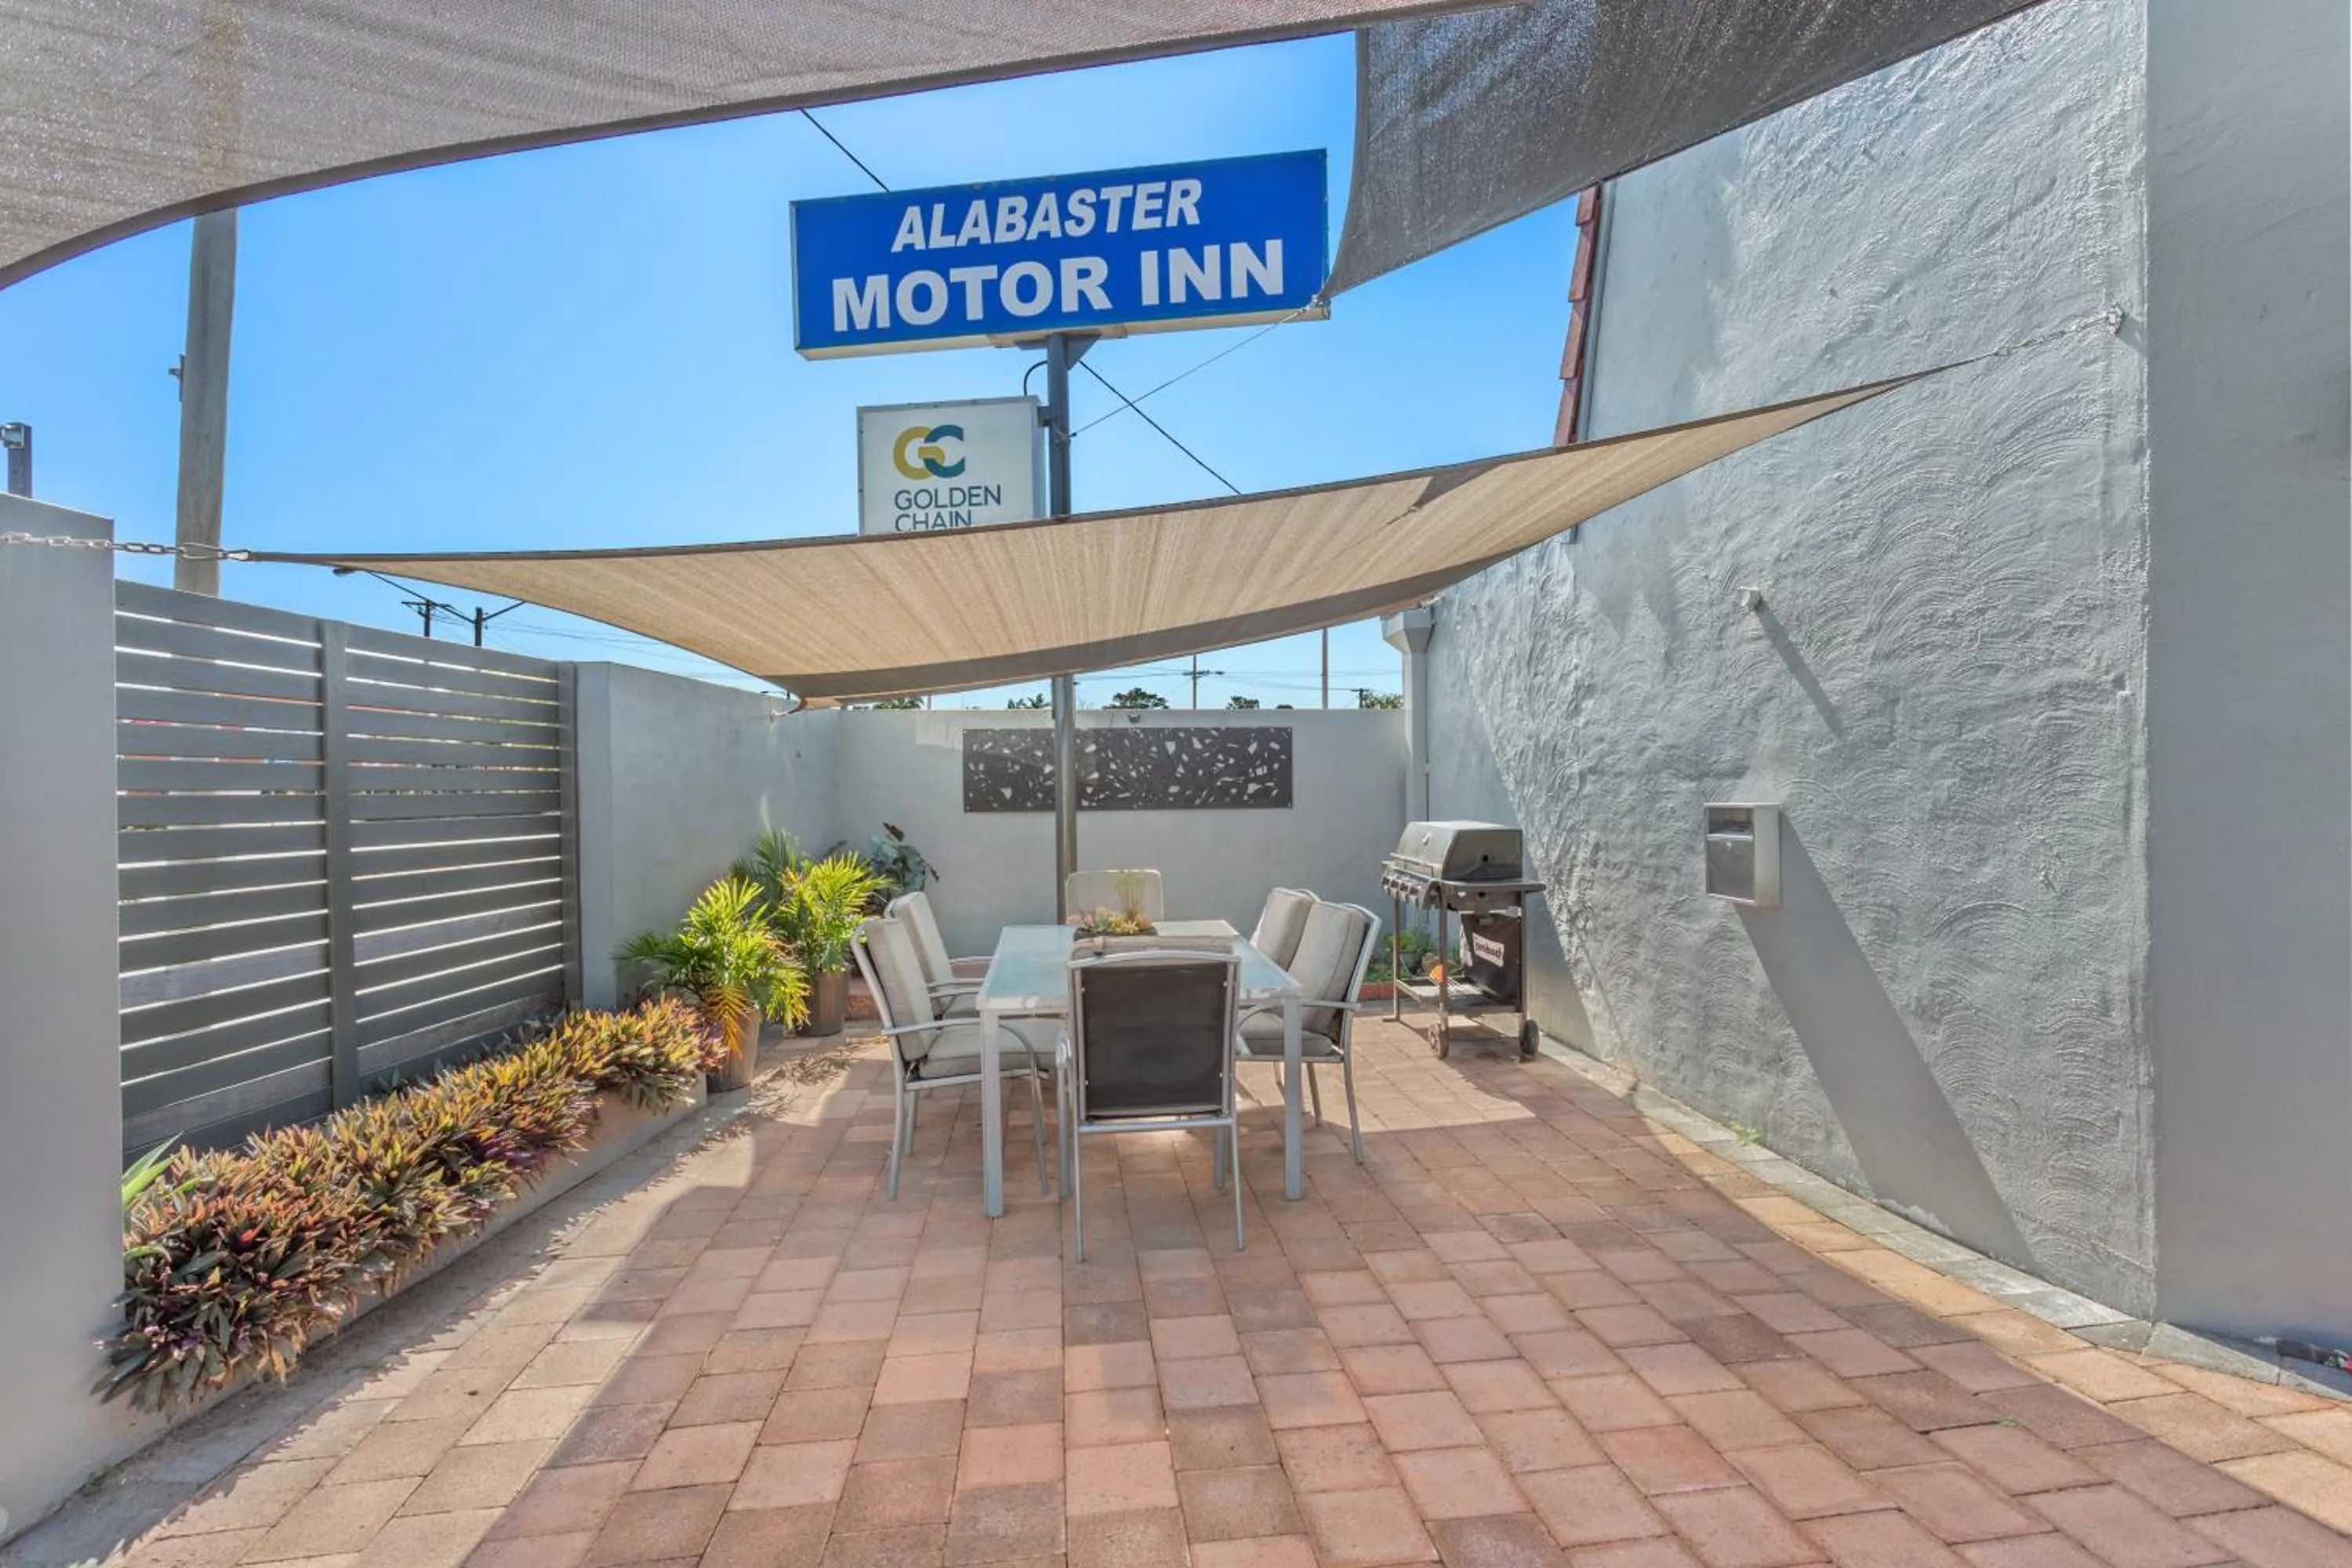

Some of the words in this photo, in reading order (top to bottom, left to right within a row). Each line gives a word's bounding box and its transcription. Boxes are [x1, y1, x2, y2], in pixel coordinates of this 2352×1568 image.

[891, 178, 1203, 253] ALABASTER
[832, 256, 1112, 332] MOTOR
[1140, 238, 1284, 307] INN
[894, 484, 1002, 511] GOLDEN
[895, 510, 972, 532] CHAIN
